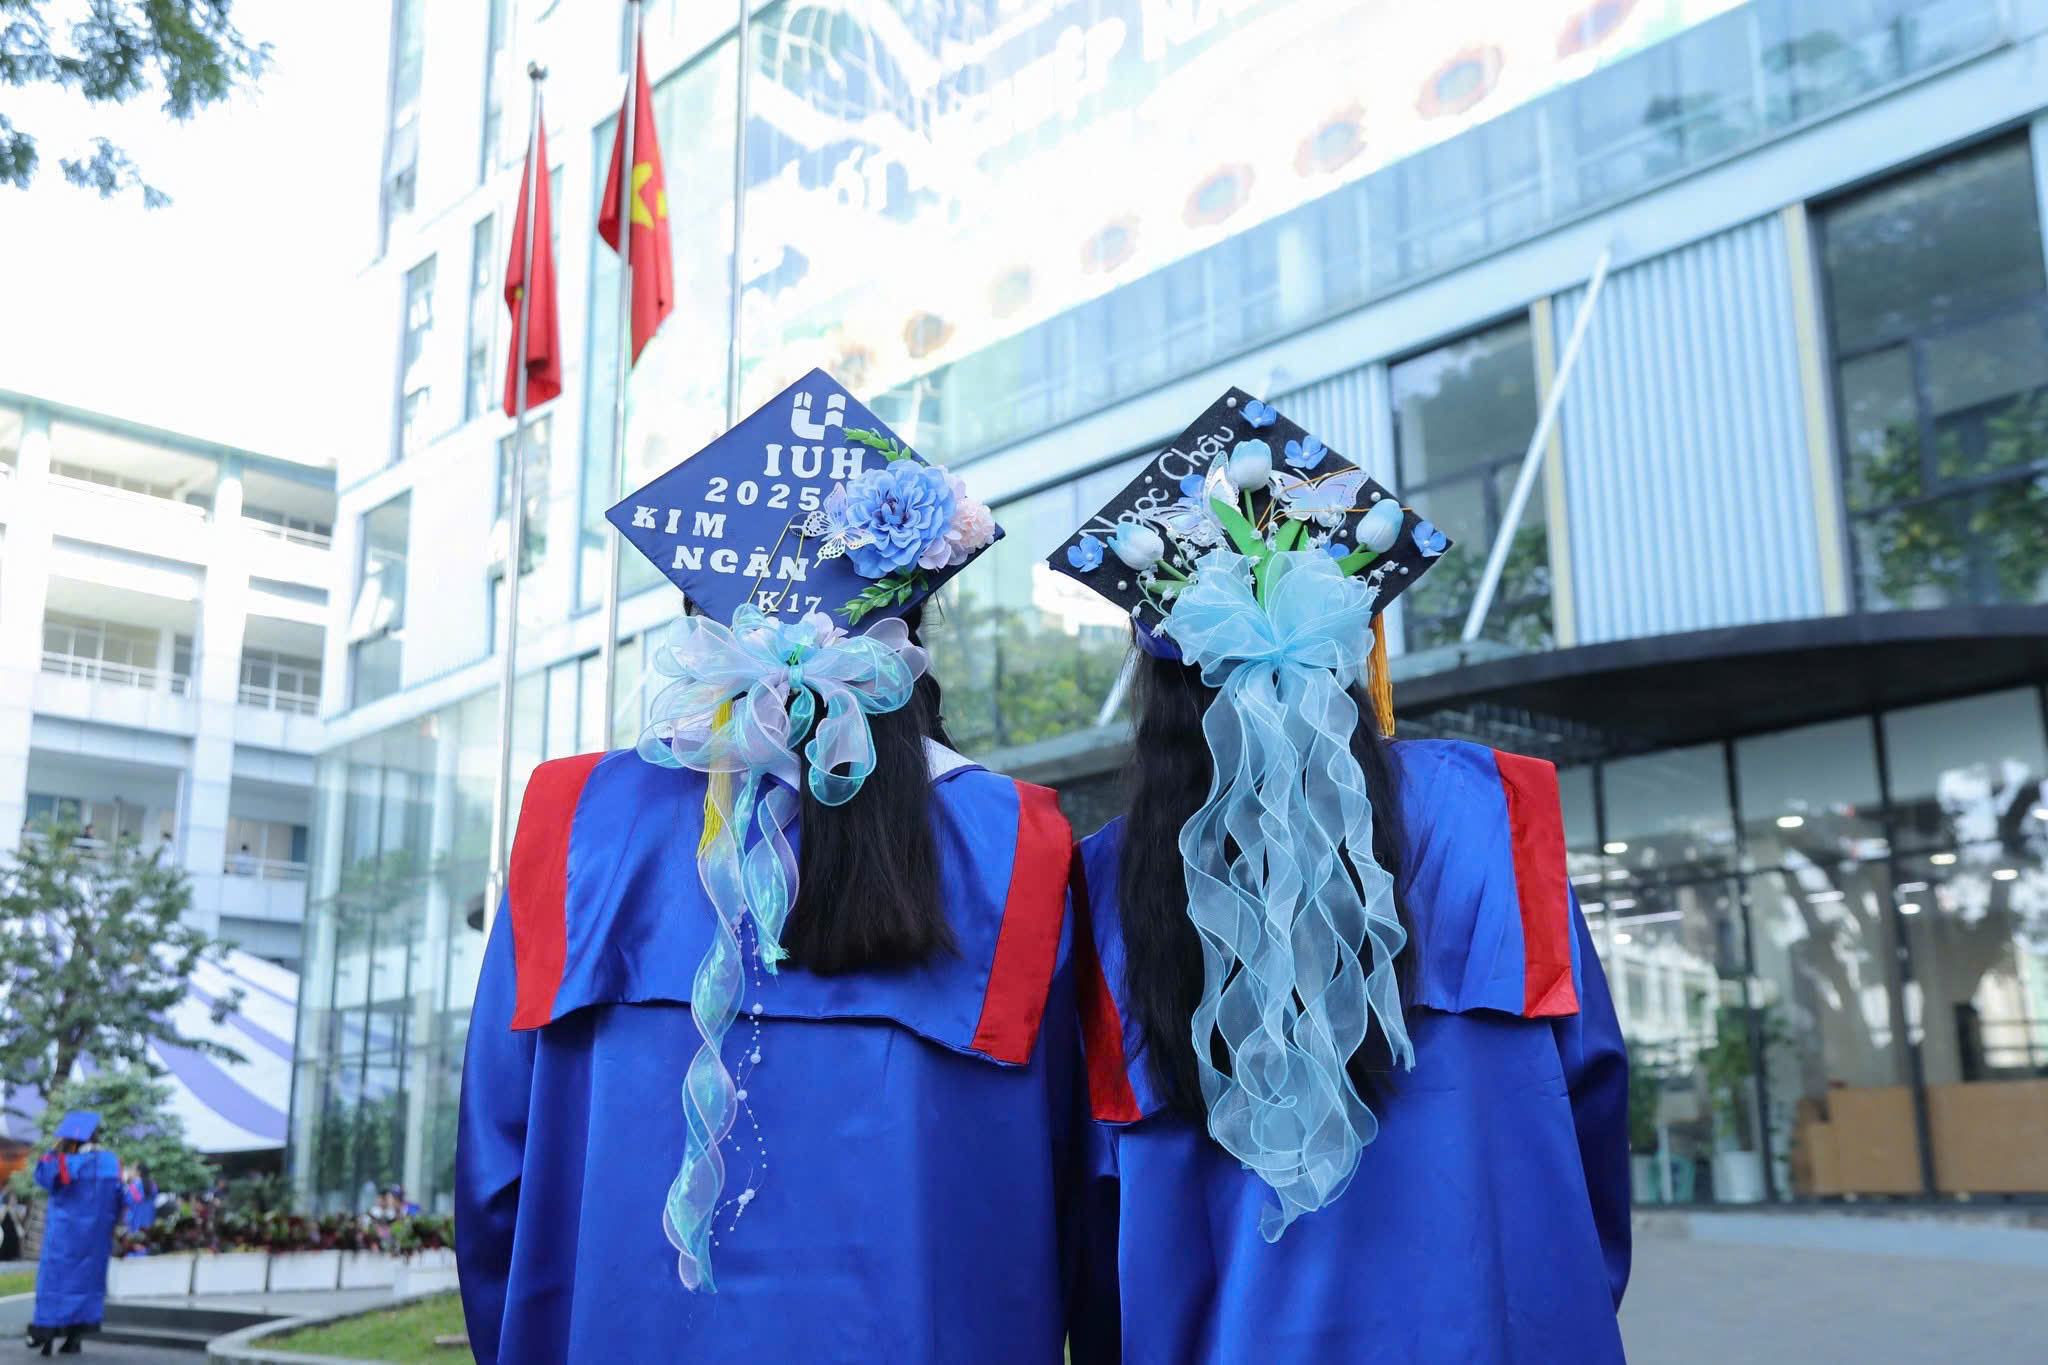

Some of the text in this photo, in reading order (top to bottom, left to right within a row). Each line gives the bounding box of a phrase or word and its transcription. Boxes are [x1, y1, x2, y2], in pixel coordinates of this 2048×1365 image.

[763, 443, 866, 479] IUH
[1158, 426, 1234, 481] Châu
[704, 477, 821, 511] 2025
[632, 505, 727, 539] KIM
[672, 545, 809, 581] NGÂN
[757, 590, 822, 616] K17
